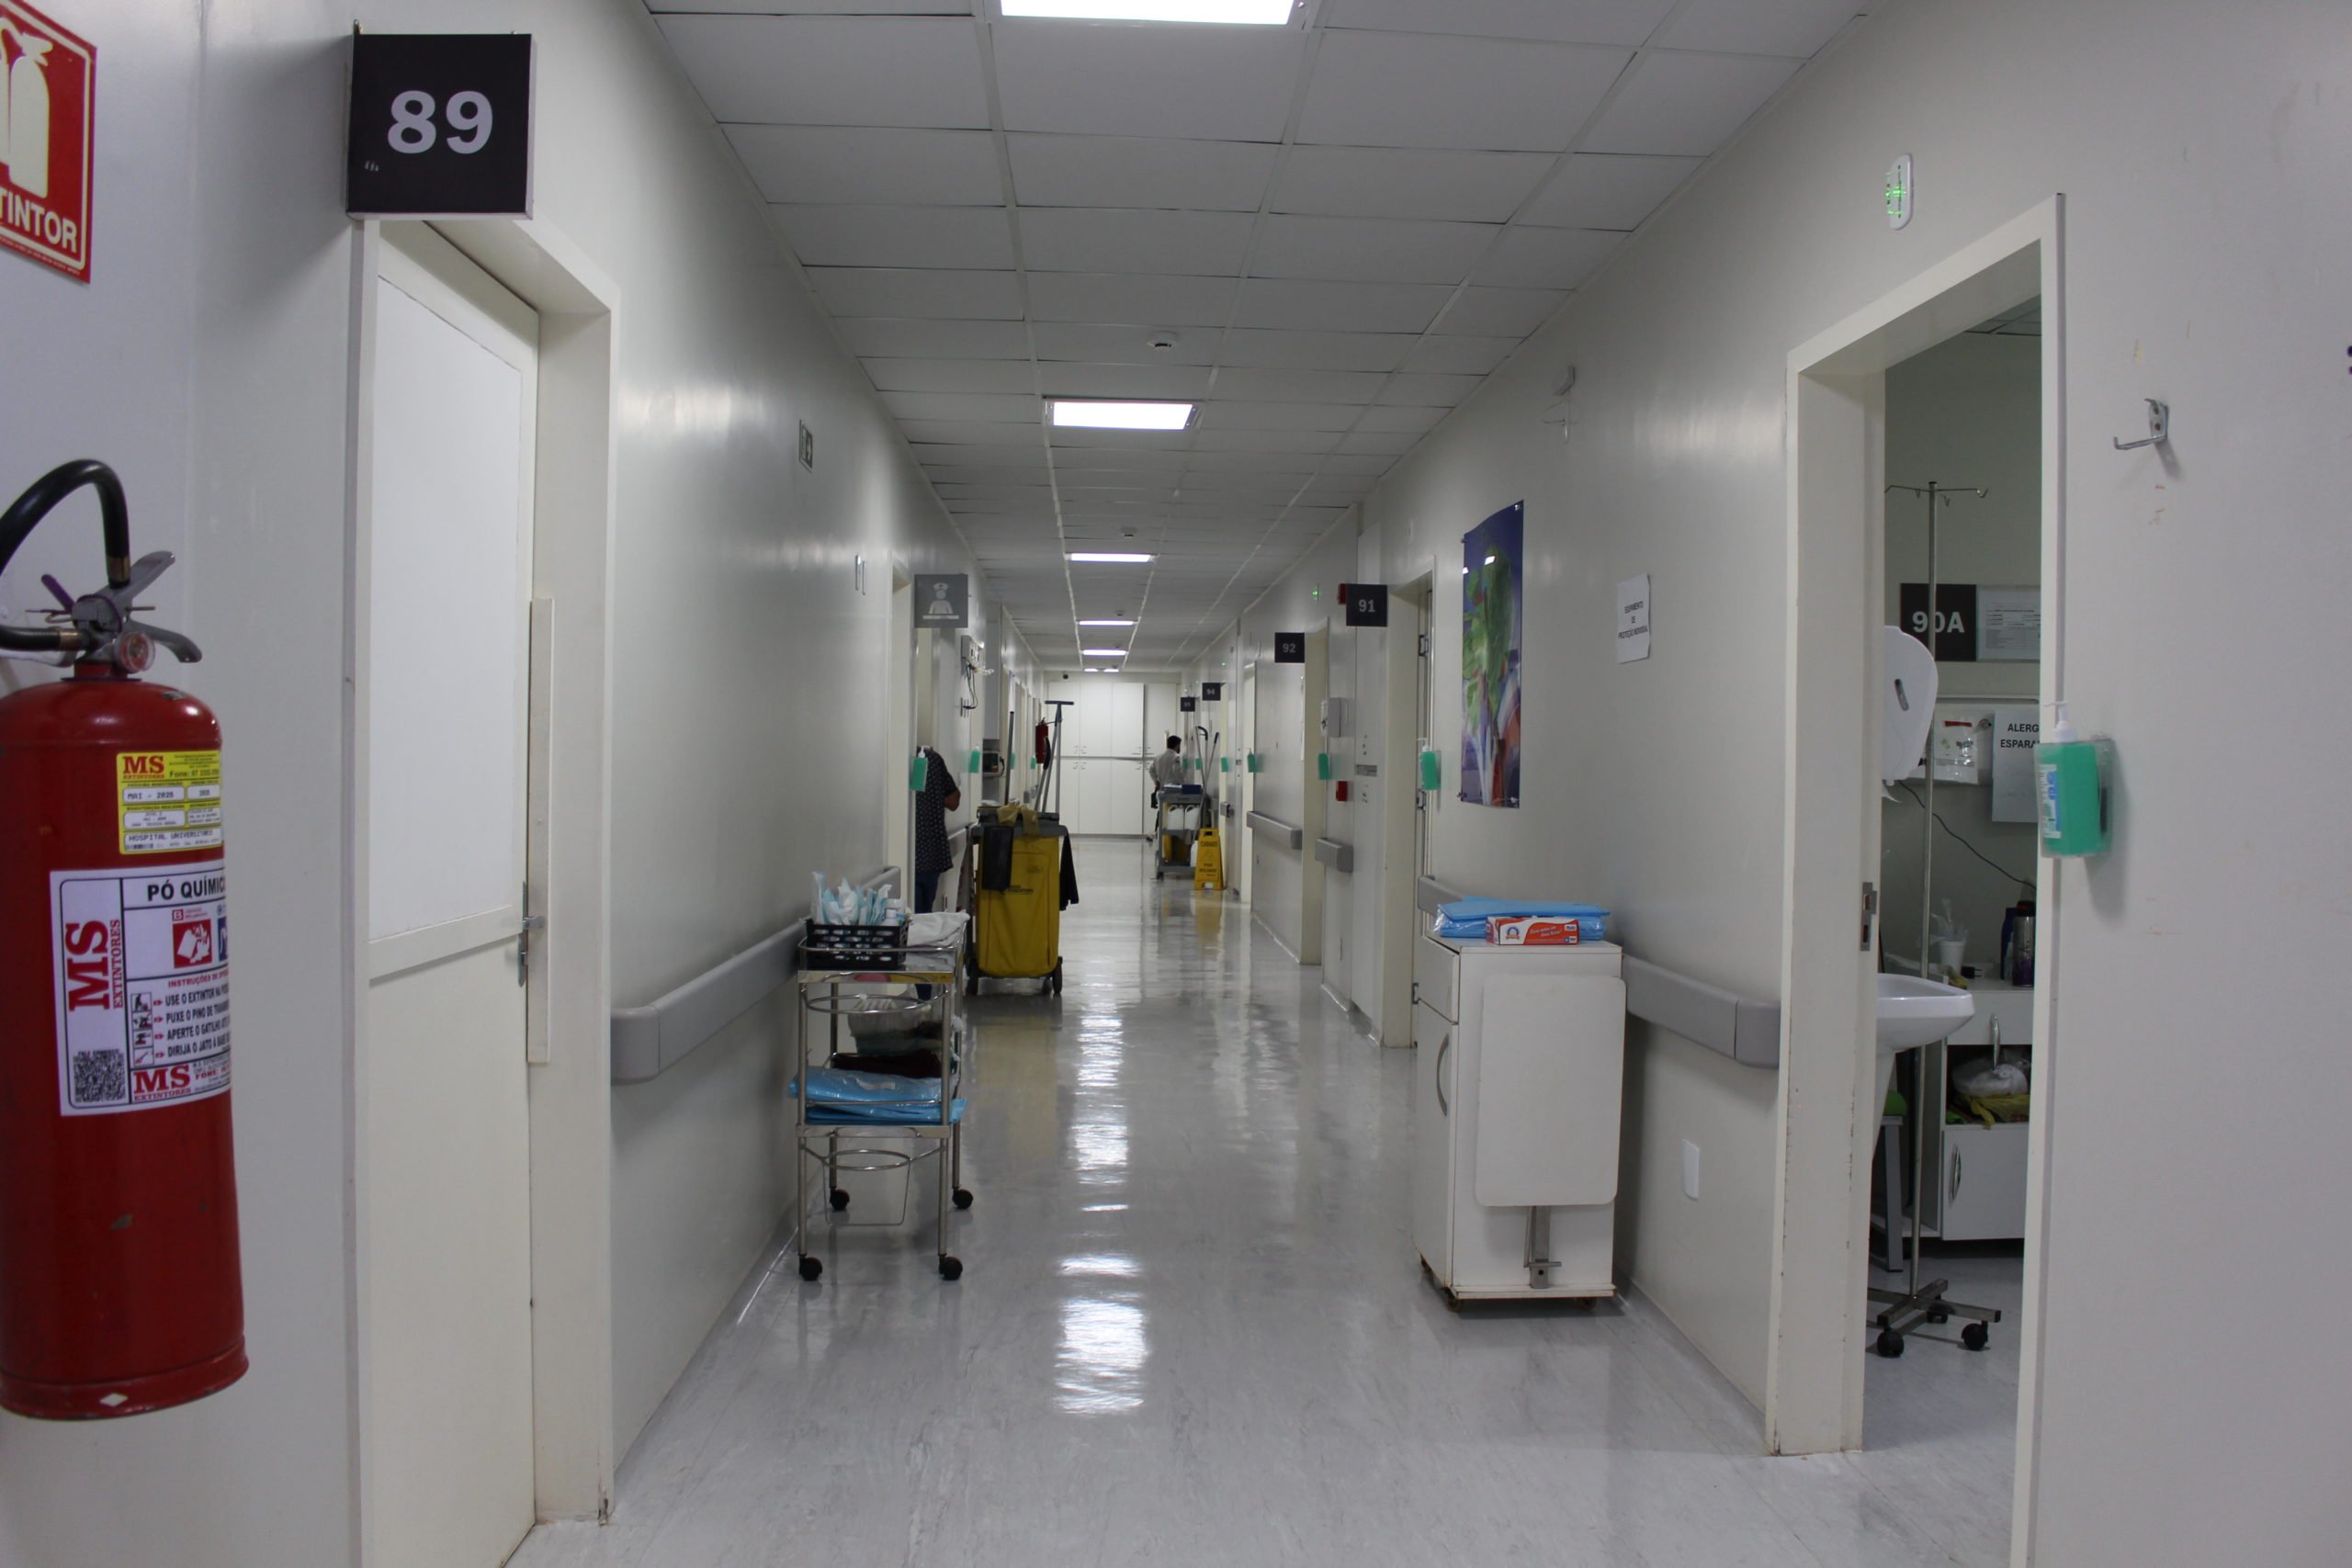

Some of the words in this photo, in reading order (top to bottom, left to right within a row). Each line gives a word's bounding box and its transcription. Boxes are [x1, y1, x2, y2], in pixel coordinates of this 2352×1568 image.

[387, 90, 494, 154] 89
[1358, 599, 1375, 613] 91
[1912, 611, 1965, 633] 90A
[1283, 643, 1296, 653] 92
[2007, 723, 2040, 733] ALERG
[2001, 739, 2040, 749] ESPAR
[122, 755, 164, 773] MS
[129, 833, 166, 841] HOSPITAL
[147, 879, 175, 902] PÓ
[65, 920, 109, 1011] MS
[109, 919, 123, 1010] EXTINTORES
[168, 975, 211, 987] INSTRUÇÕES
[165, 994, 180, 1007] USE
[181, 993, 187, 1004] O
[188, 987, 214, 1003] EXTINTOR
[166, 1011, 185, 1023] PUXE
[186, 1010, 191, 1021] O
[167, 1026, 194, 1041] APERTE
[195, 1024, 200, 1036] O
[167, 1043, 191, 1057] DIRIJA
[192, 1042, 198, 1054] O
[133, 1064, 190, 1094] MS
[134, 1088, 191, 1101] EXTINTORES
